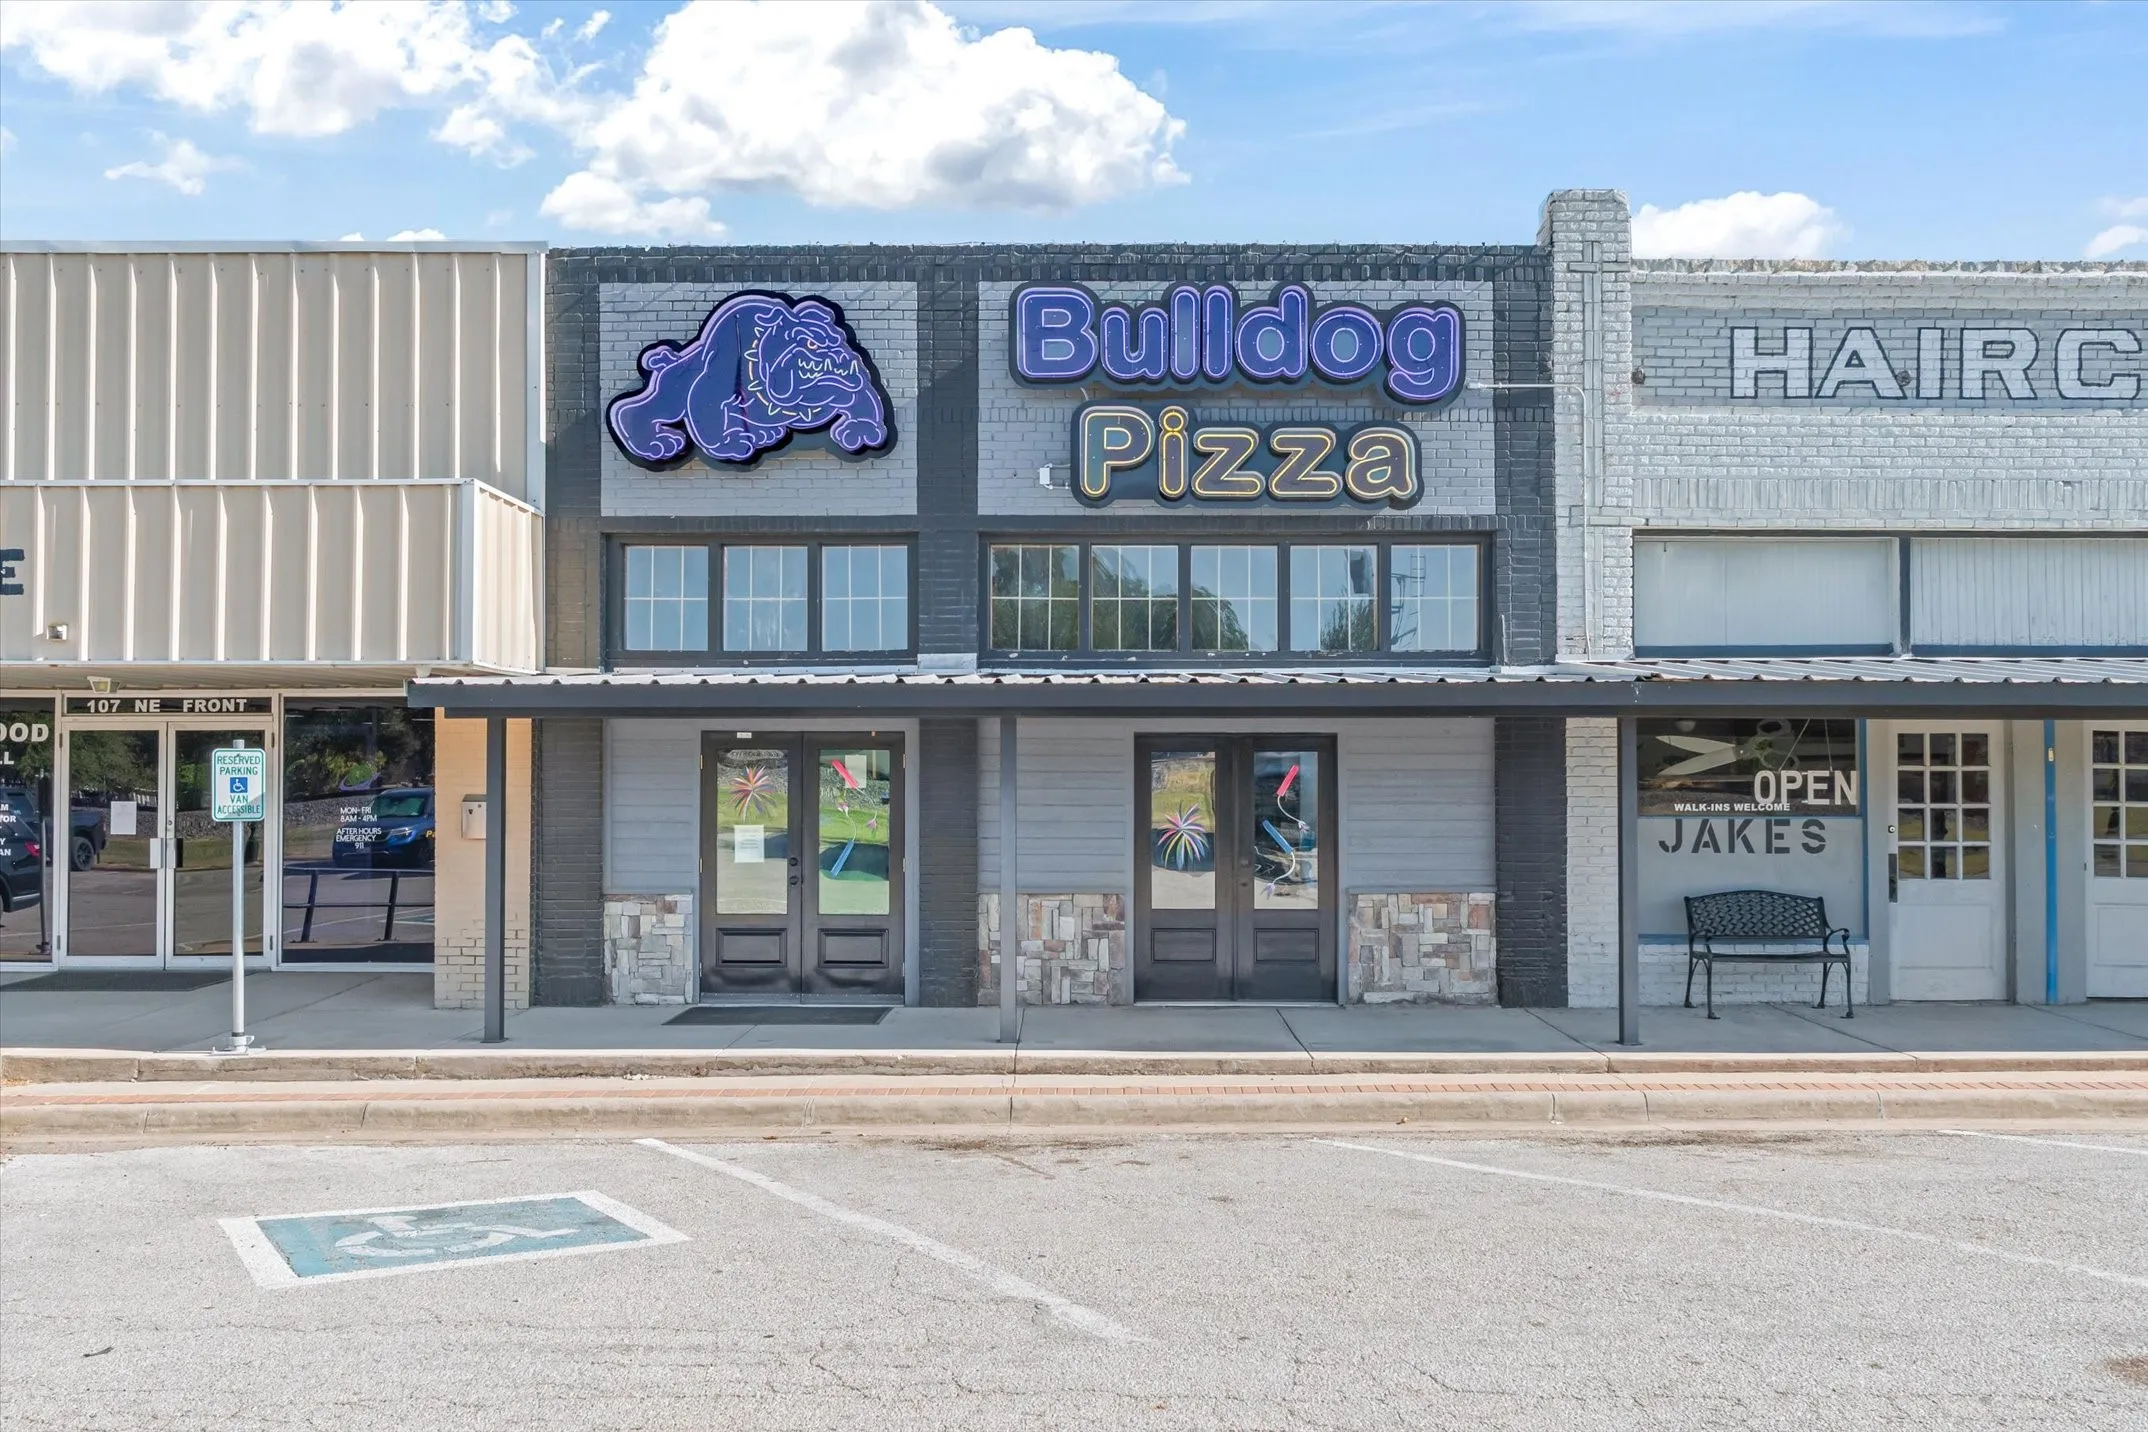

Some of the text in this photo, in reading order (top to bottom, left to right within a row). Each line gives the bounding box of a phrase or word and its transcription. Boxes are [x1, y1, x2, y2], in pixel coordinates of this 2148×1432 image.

[1016, 284, 1462, 403] Bulldog
[1730, 326, 2143, 400] HAIRC
[1078, 405, 1418, 500] Pizza
[87, 698, 248, 713] 107 NE FRONT
[216, 755, 261, 765] RESERVED
[219, 766, 259, 776] PARKING
[1754, 770, 1858, 806] OPEN
[230, 795, 249, 804] VAN
[216, 805, 261, 815] ACCESSIBLE
[361, 806, 372, 814] FRI
[1674, 803, 1791, 812] WALK-INS WELCOME
[340, 814, 358, 823] 8AM
[362, 814, 378, 822] 4PM
[336, 827, 382, 835] AFTER HOURS
[1658, 818, 1826, 854] JAKES
[335, 834, 377, 842] EMERGENCY
